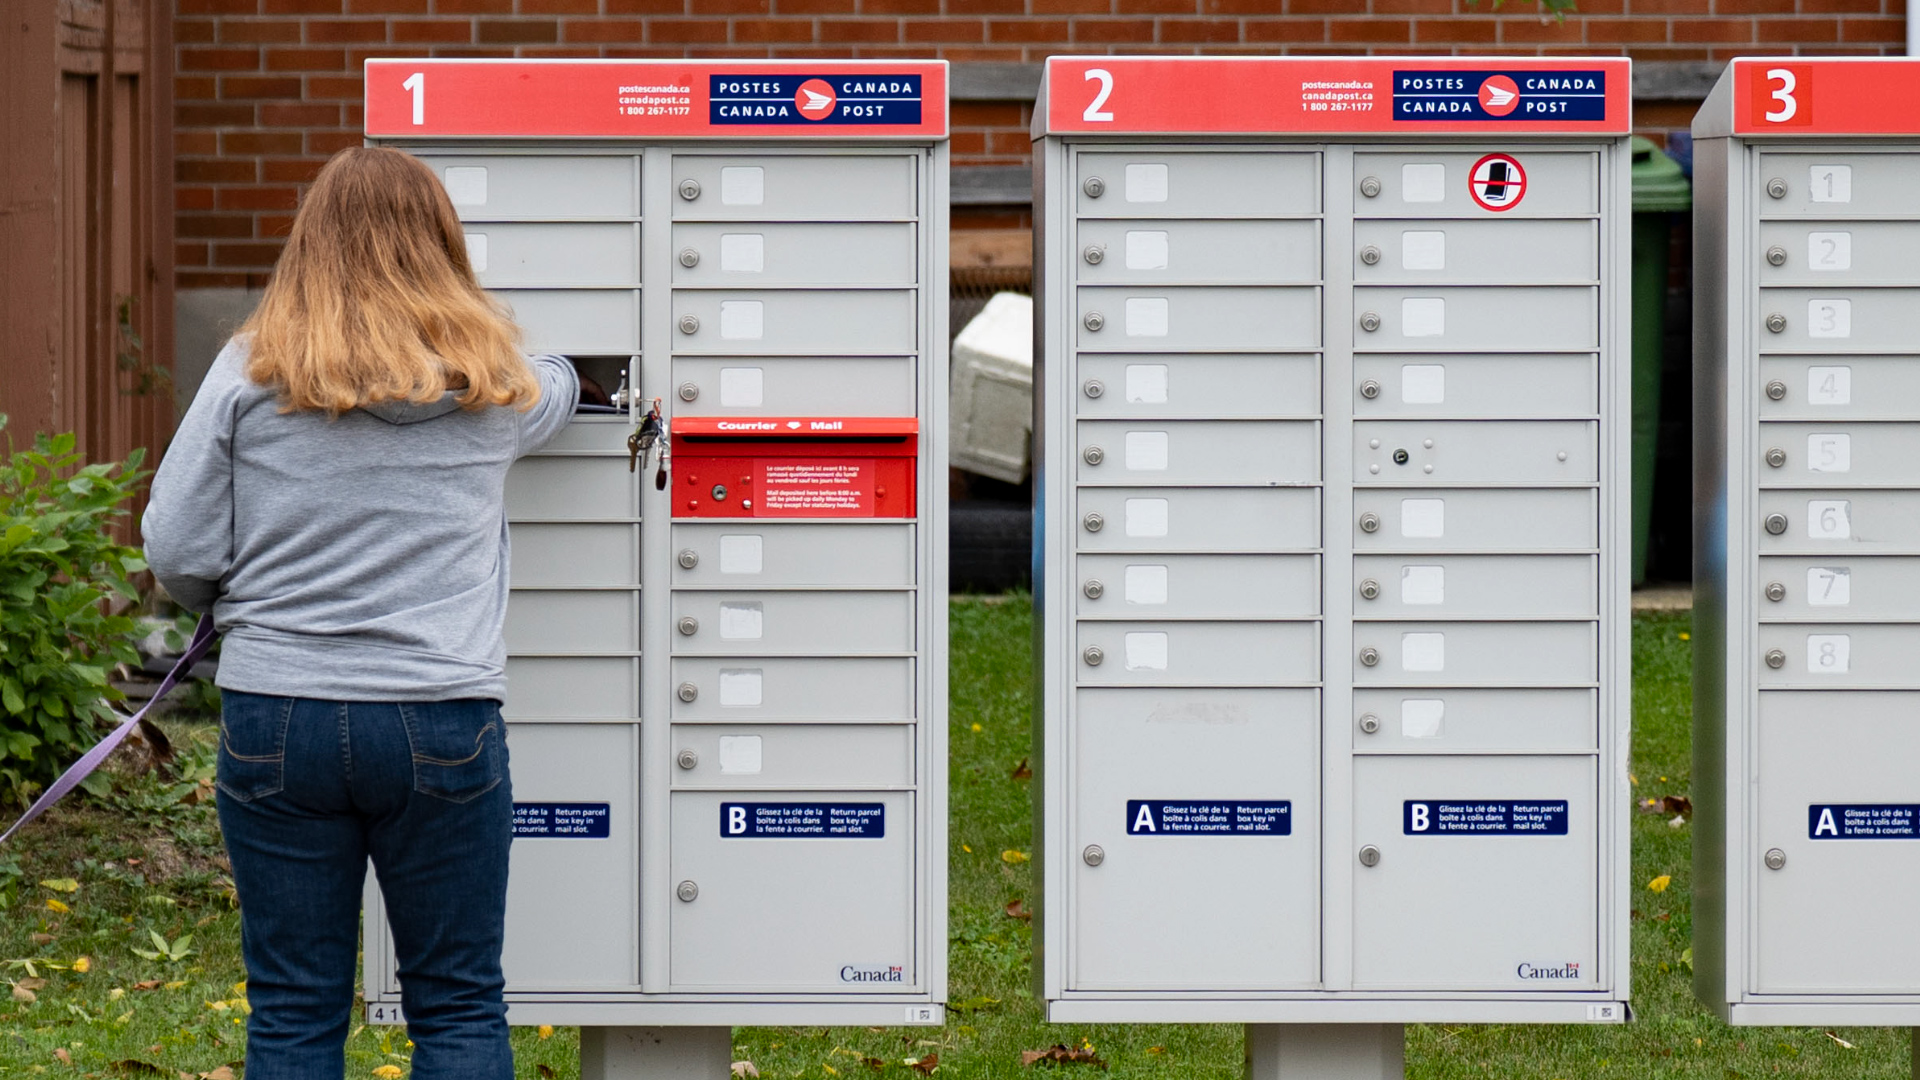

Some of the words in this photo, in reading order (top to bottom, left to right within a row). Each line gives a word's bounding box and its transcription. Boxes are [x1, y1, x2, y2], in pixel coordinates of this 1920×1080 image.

[720, 83, 780, 93] POSTES
[843, 83, 912, 93] CANADA
[1302, 80, 1373, 91] postescanada.ca
[1403, 79, 1463, 89] POSTES
[1526, 79, 1595, 89] CANADA
[619, 84, 690, 95] postescanada.ca
[402, 72, 424, 125] 1
[1082, 68, 1115, 122] 2
[1302, 91, 1373, 102] canadapost.ca
[1765, 68, 1797, 122] 3
[619, 95, 690, 106] canadapost.ca
[619, 106, 624, 115] 1
[627, 106, 645, 115] 800
[647, 107, 690, 115] 267-1177
[720, 106, 788, 117] CANADA
[843, 106, 884, 116] POST
[1302, 103, 1307, 111] 1
[1310, 102, 1328, 111] 800
[1330, 102, 1373, 111] 267-1177
[1403, 102, 1472, 112] CANADA
[1527, 102, 1567, 113] POST
[1823, 172, 1833, 198] 1
[1821, 238, 1836, 264] 2
[1821, 306, 1836, 331] 3
[1820, 373, 1838, 399] 4
[717, 422, 777, 430] Courrier
[810, 421, 843, 430] Mail
[1821, 440, 1836, 465] 5
[1821, 507, 1836, 530] 6
[1819, 575, 1836, 599] 7
[1819, 642, 1836, 666] 8
[555, 808, 581, 816] Return
[582, 809, 606, 817] parcel
[756, 808, 781, 816] Glissez
[783, 808, 790, 816] la
[792, 808, 803, 816] clé
[830, 808, 856, 816] Return
[857, 809, 881, 817] parcel
[1237, 806, 1263, 814] Return
[1264, 806, 1287, 814] parcel
[1439, 805, 1464, 813] Glissez
[1466, 805, 1473, 813] la
[1474, 805, 1485, 813] clé
[1487, 805, 1497, 813] de
[1498, 805, 1506, 813] la
[1540, 805, 1563, 813] parcel
[1844, 809, 1870, 817] Glissez
[571, 816, 585, 825] key
[729, 807, 747, 834] B
[846, 816, 860, 826] key
[1133, 804, 1156, 832] A
[1237, 815, 1252, 823] box
[1253, 815, 1266, 824] key
[1268, 815, 1275, 823] in
[1412, 804, 1430, 831] B
[1529, 814, 1543, 822] key
[1815, 808, 1838, 836] A
[1873, 818, 1890, 826] colis
[1891, 818, 1909, 826] dans
[555, 825, 572, 833] mail
[756, 825, 763, 833] la
[765, 825, 785, 833] fente
[830, 825, 847, 833] mail
[1163, 823, 1170, 831] la
[1172, 823, 1192, 831] fente
[1237, 823, 1254, 831] mail
[1255, 823, 1270, 831] slot.
[1448, 822, 1468, 830] fente
[1513, 822, 1530, 830] mail
[1531, 822, 1547, 830] slot.
[1854, 826, 1874, 834] fente
[840, 966, 902, 982] Canada
[1517, 963, 1579, 979] Canada
